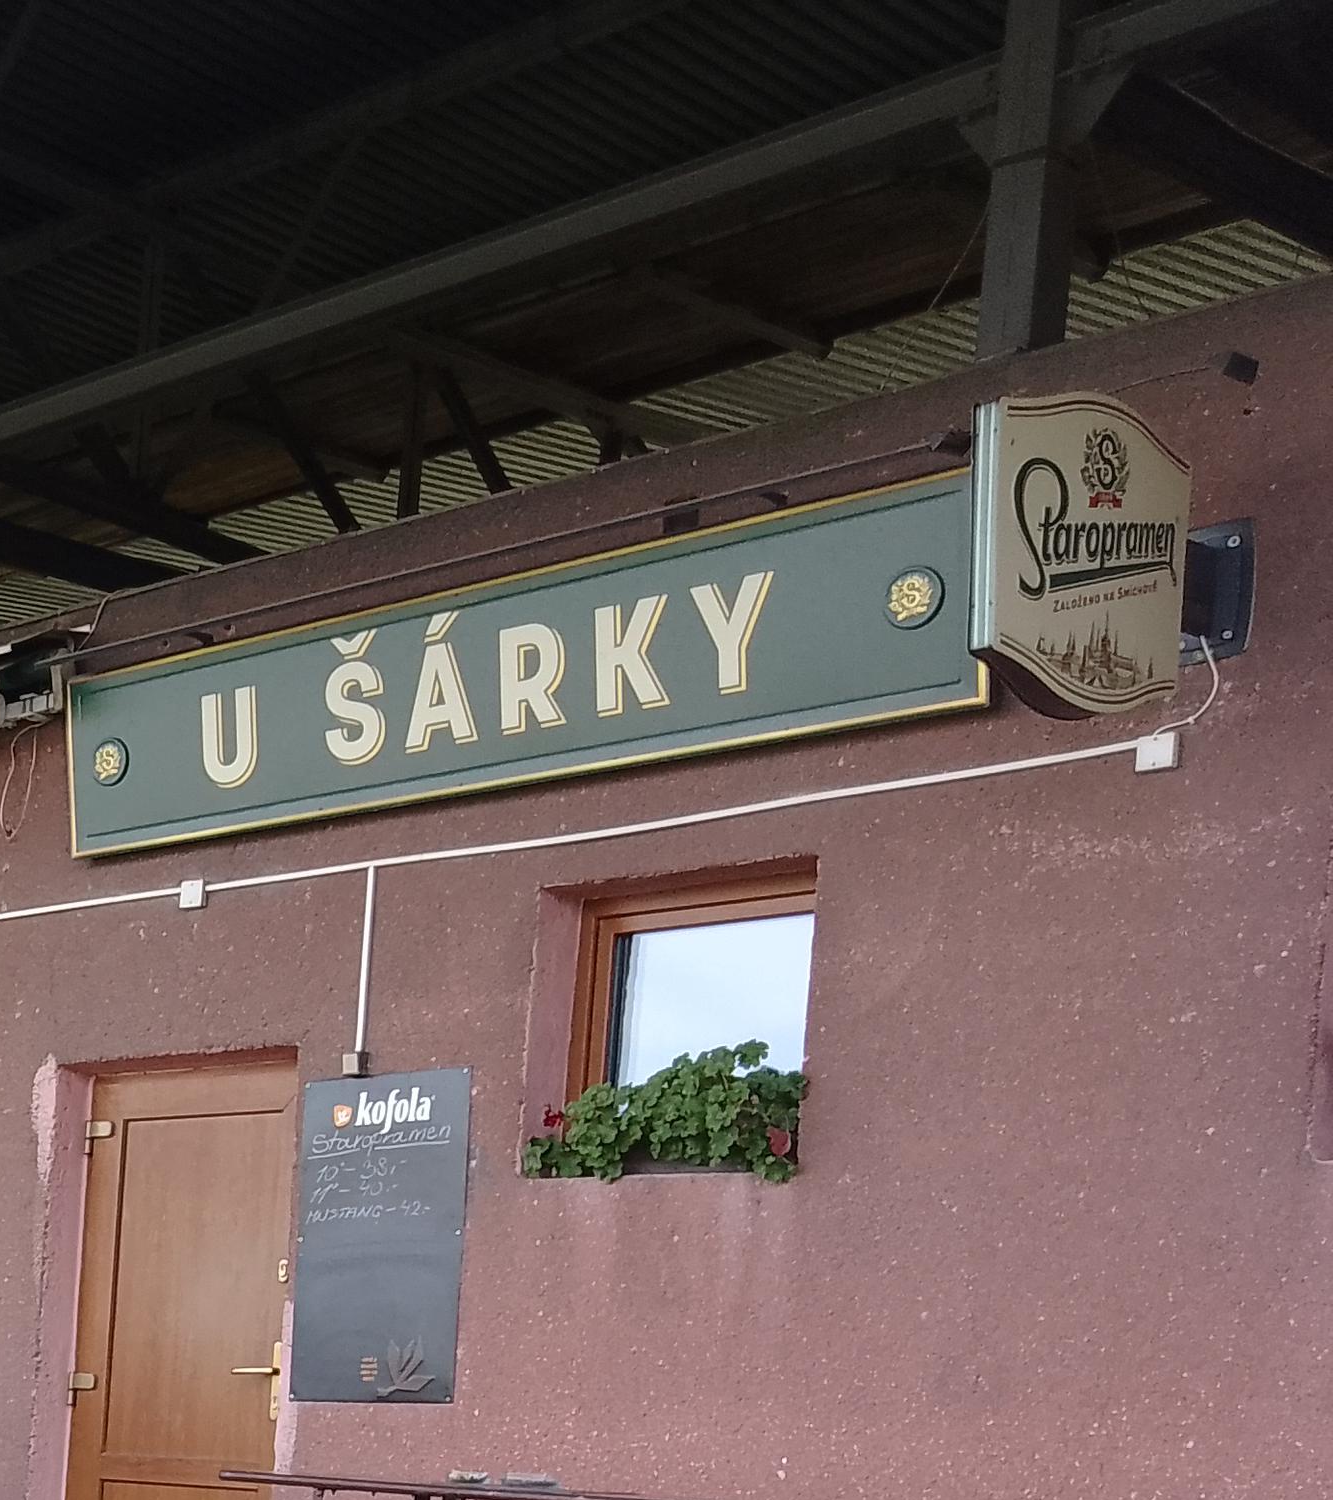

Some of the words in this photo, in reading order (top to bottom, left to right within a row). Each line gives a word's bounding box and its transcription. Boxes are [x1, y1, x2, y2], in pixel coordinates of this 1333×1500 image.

[1014, 457, 1177, 600] Staropramen
[199, 685, 259, 789] U
[324, 571, 775, 766] ŠÁRKY
[354, 1087, 432, 1134] kofola
[312, 1125, 451, 1156] Staropramen
[305, 1204, 384, 1225] MUSTANG
